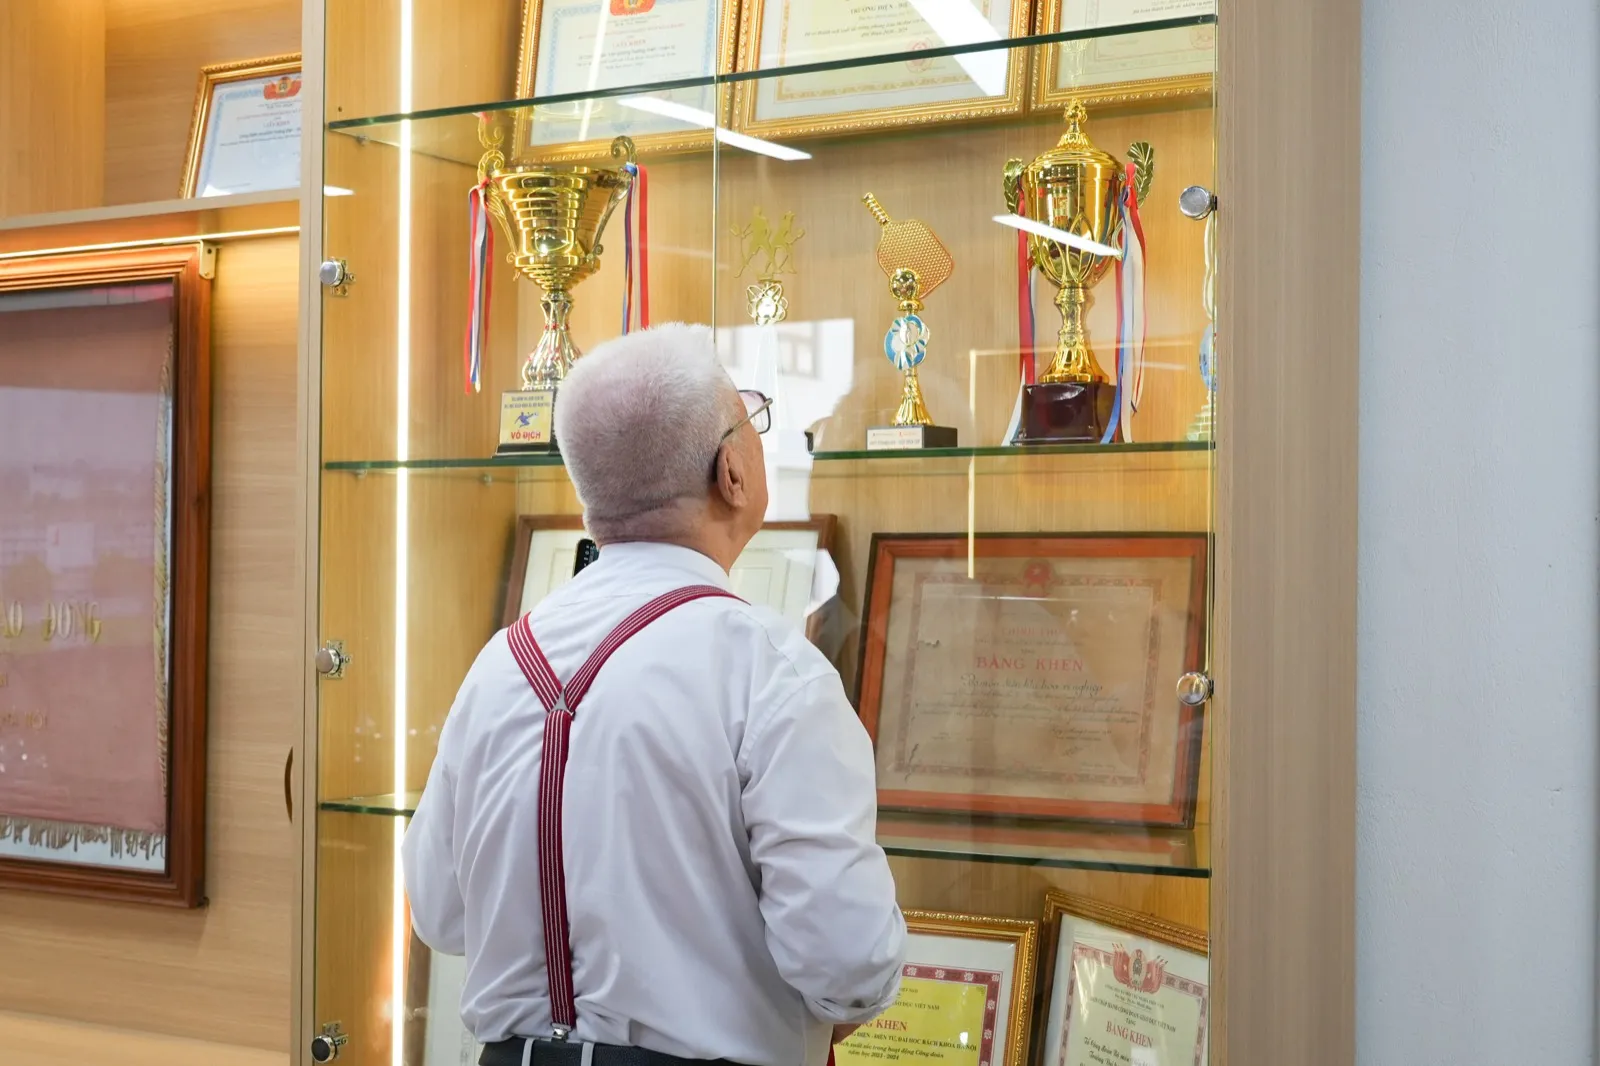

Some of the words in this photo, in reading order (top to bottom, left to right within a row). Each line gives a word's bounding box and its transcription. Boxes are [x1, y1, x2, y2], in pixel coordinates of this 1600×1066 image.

[1036, 658, 1084, 672] KHEN
[876, 1019, 908, 1032] KHEN
[1130, 1030, 1154, 1048] KHEN
